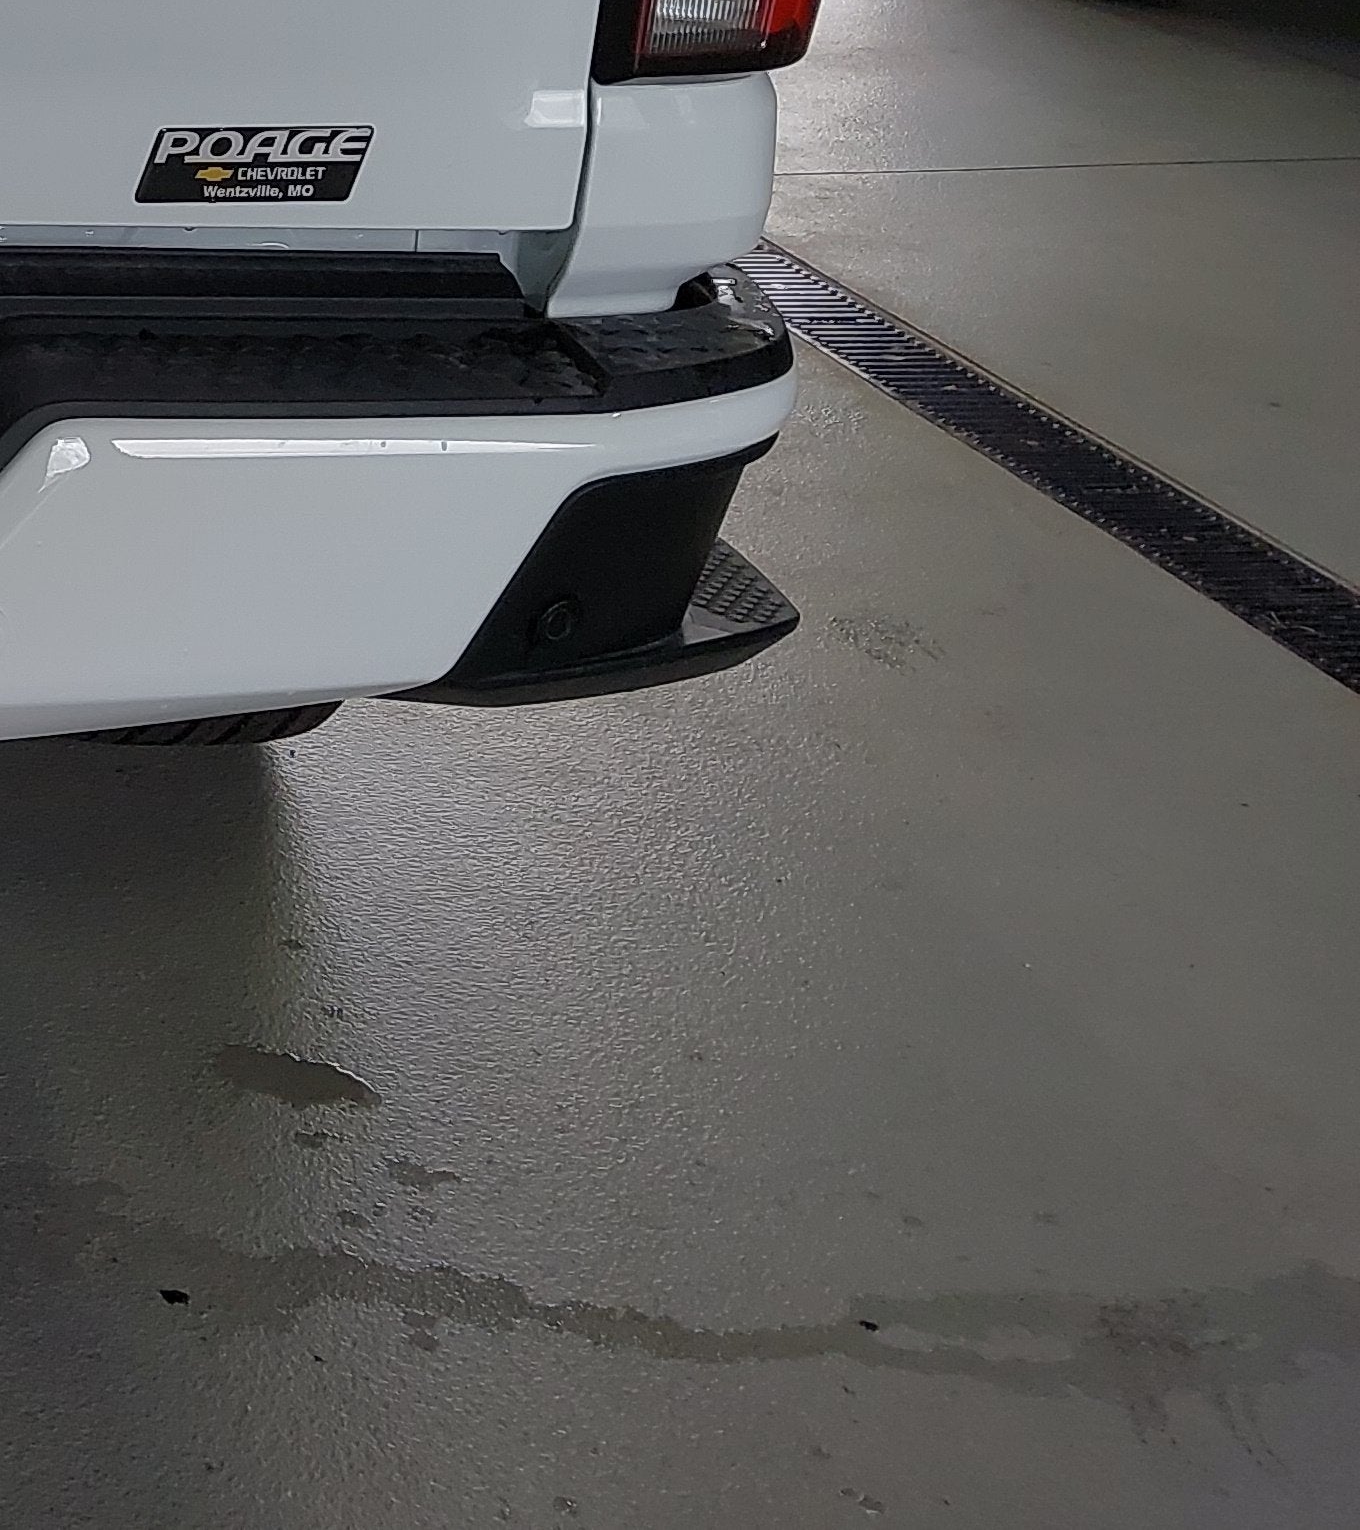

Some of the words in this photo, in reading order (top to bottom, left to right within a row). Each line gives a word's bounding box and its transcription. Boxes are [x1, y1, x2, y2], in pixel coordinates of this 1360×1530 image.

[153, 127, 372, 164] POAGE
[237, 166, 327, 181] CHEVROLET
[203, 184, 283, 199] Wentzville,
[287, 184, 314, 197] MO
